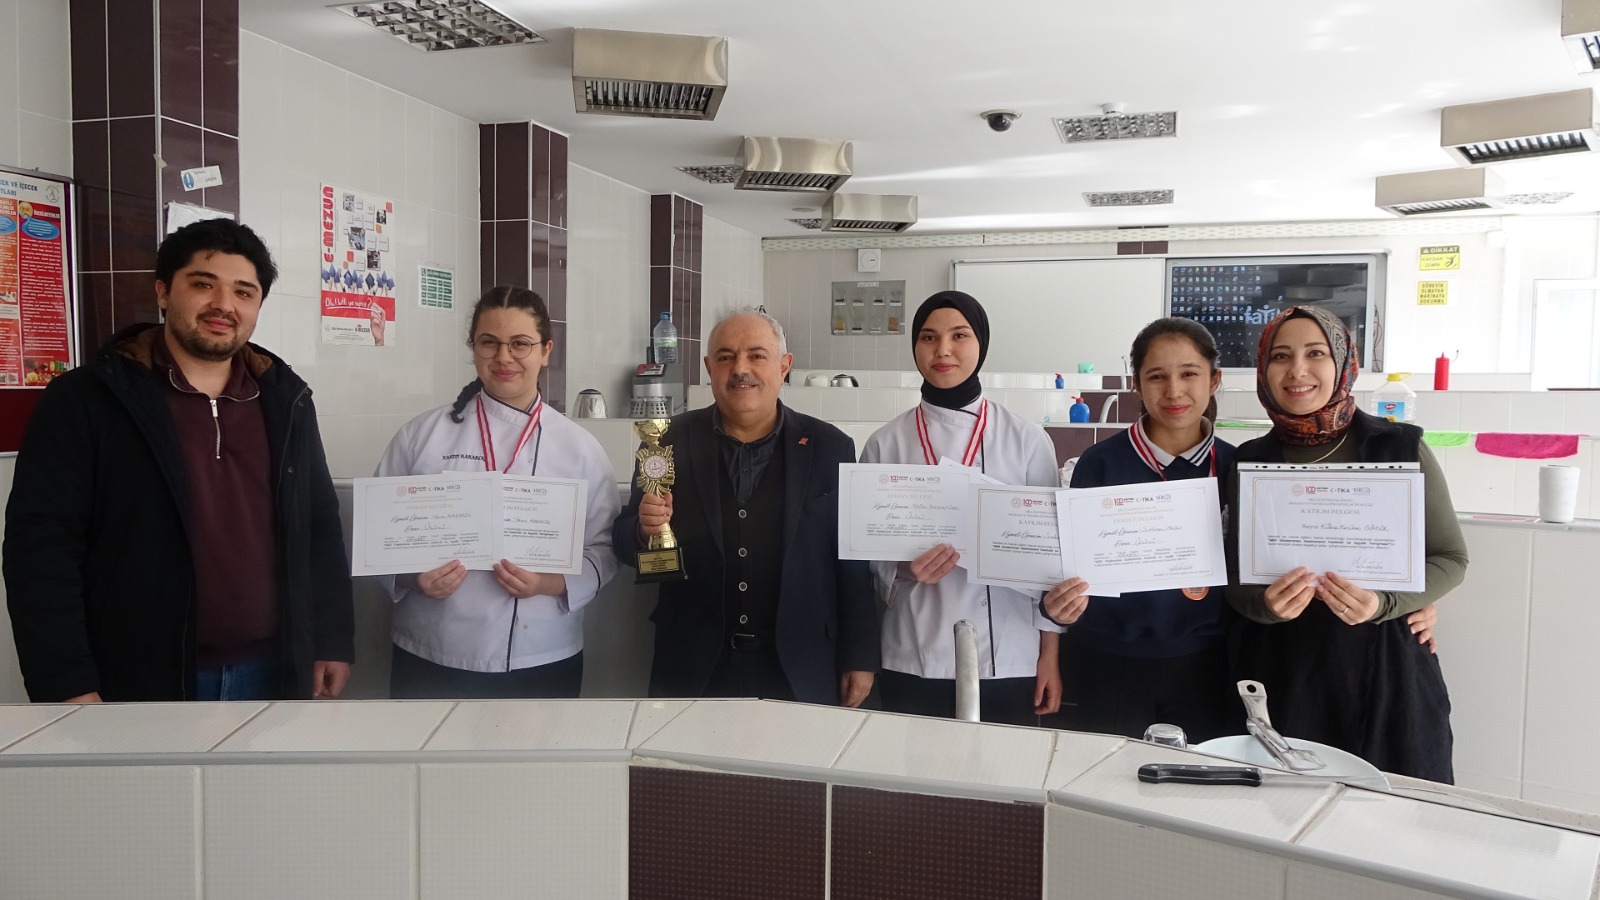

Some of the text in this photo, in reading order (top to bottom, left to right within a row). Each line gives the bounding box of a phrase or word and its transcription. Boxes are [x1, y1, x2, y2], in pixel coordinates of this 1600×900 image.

[19, 182, 38, 191] İÇECEK
[322, 186, 335, 263] E-MEZUN
[1430, 246, 1458, 254] DİKKAT
